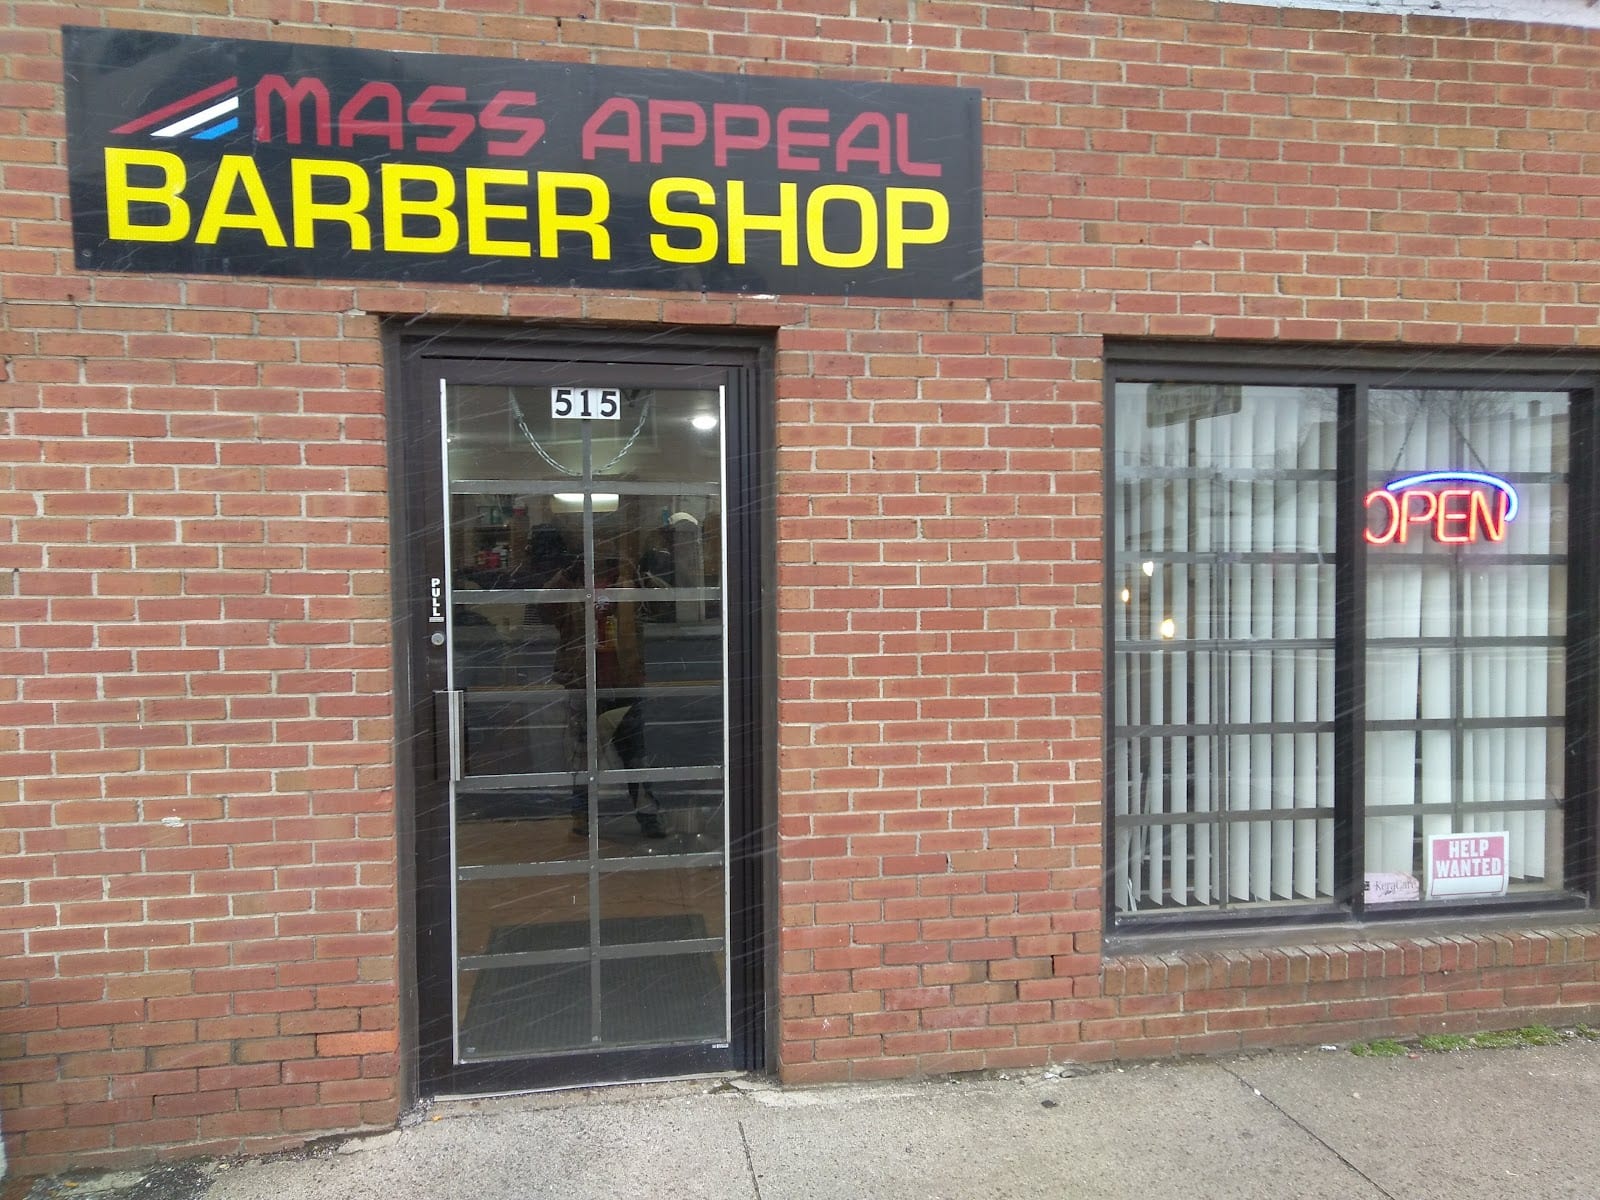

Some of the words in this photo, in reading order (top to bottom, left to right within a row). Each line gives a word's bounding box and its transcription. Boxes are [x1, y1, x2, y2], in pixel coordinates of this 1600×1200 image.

[255, 74, 546, 157] MASS
[582, 97, 942, 177] APPEAL
[103, 146, 611, 260] BARBER
[649, 176, 950, 270] SHOP
[555, 389, 617, 417] 515
[1364, 488, 1507, 544] OPEN
[431, 577, 441, 617] PULL
[1435, 857, 1501, 878] WANTED
[1449, 838, 1489, 858] HELP
